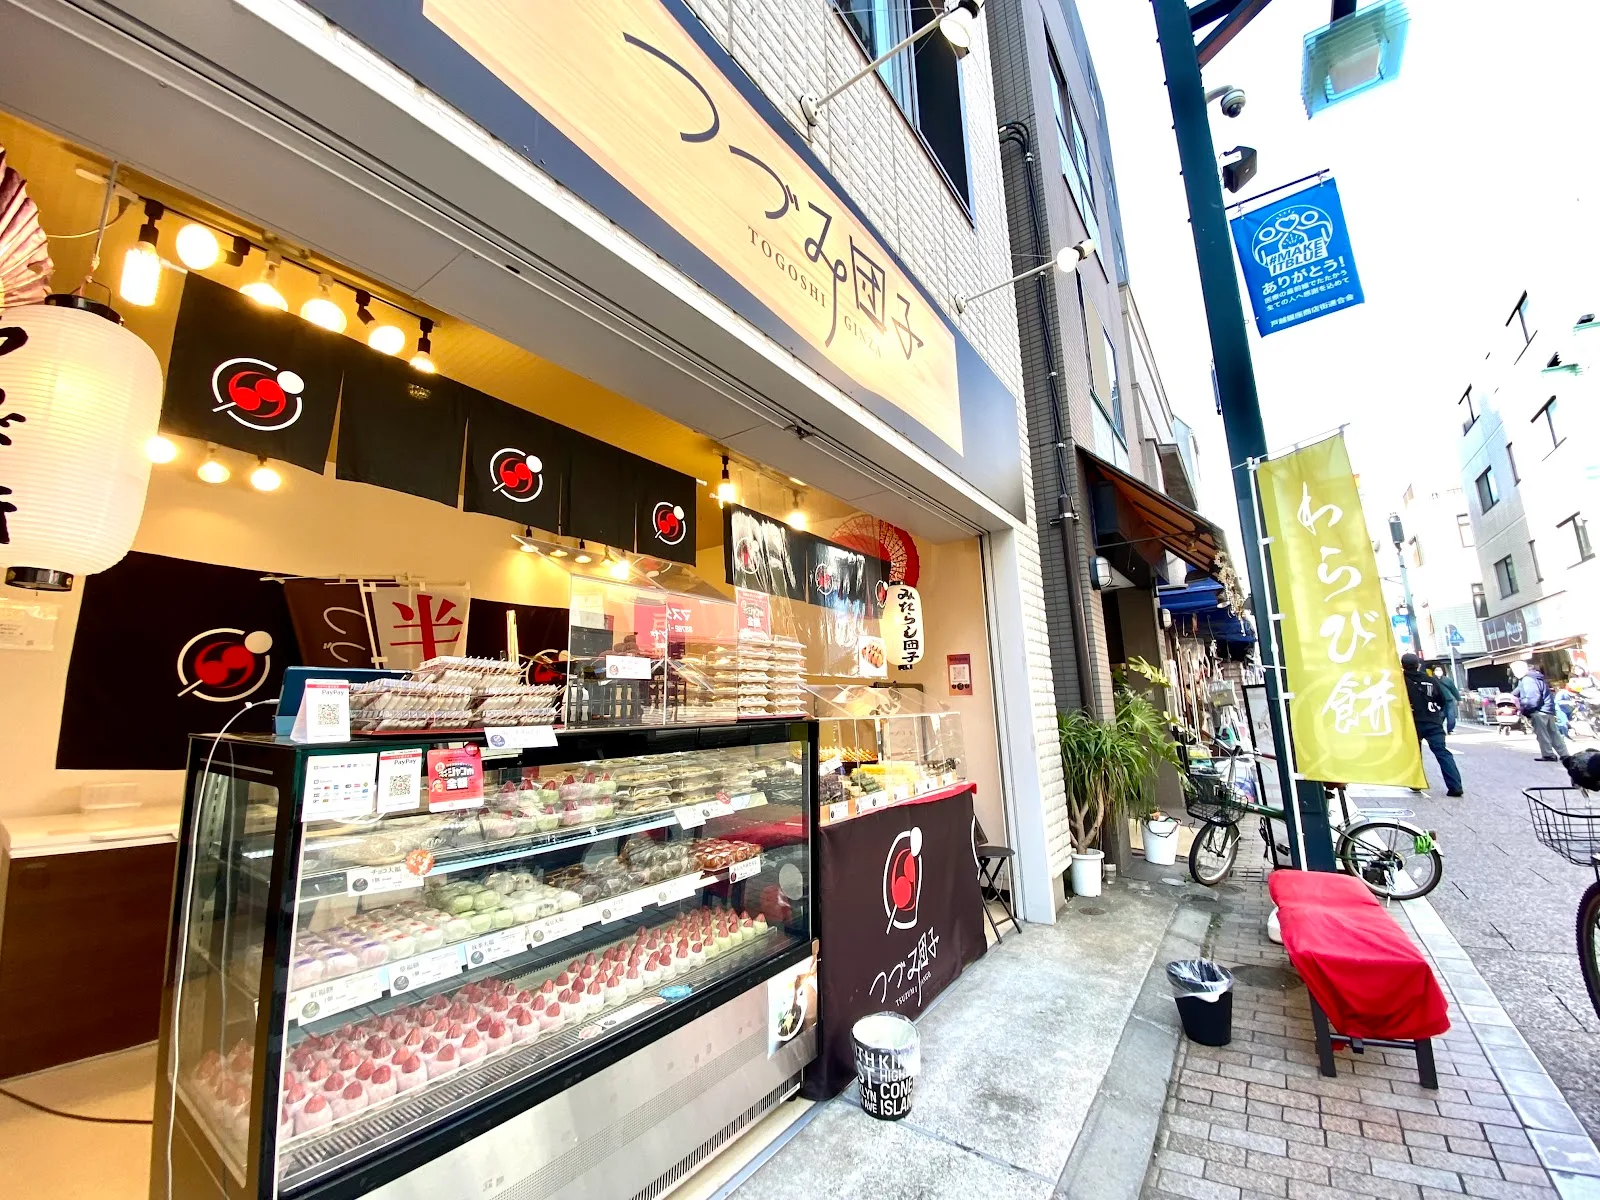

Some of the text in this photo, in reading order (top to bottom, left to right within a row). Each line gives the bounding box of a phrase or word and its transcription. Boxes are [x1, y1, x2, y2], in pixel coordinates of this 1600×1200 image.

[622, 31, 924, 360] つづみ団子
[1261, 255, 1346, 296] ありがとう!
[1268, 238, 1324, 266] #MAKE
[1272, 249, 1324, 275] ITBLUE
[747, 225, 882, 358] TOGOSHI GINZA
[389, 594, 464, 662] 半
[897, 588, 919, 663] みたらし団子
[1297, 481, 1397, 736] わらび餅
[321, 689, 345, 697] PayPay
[393, 758, 417, 767] PayPay
[868, 926, 941, 1008] つづみ団子
